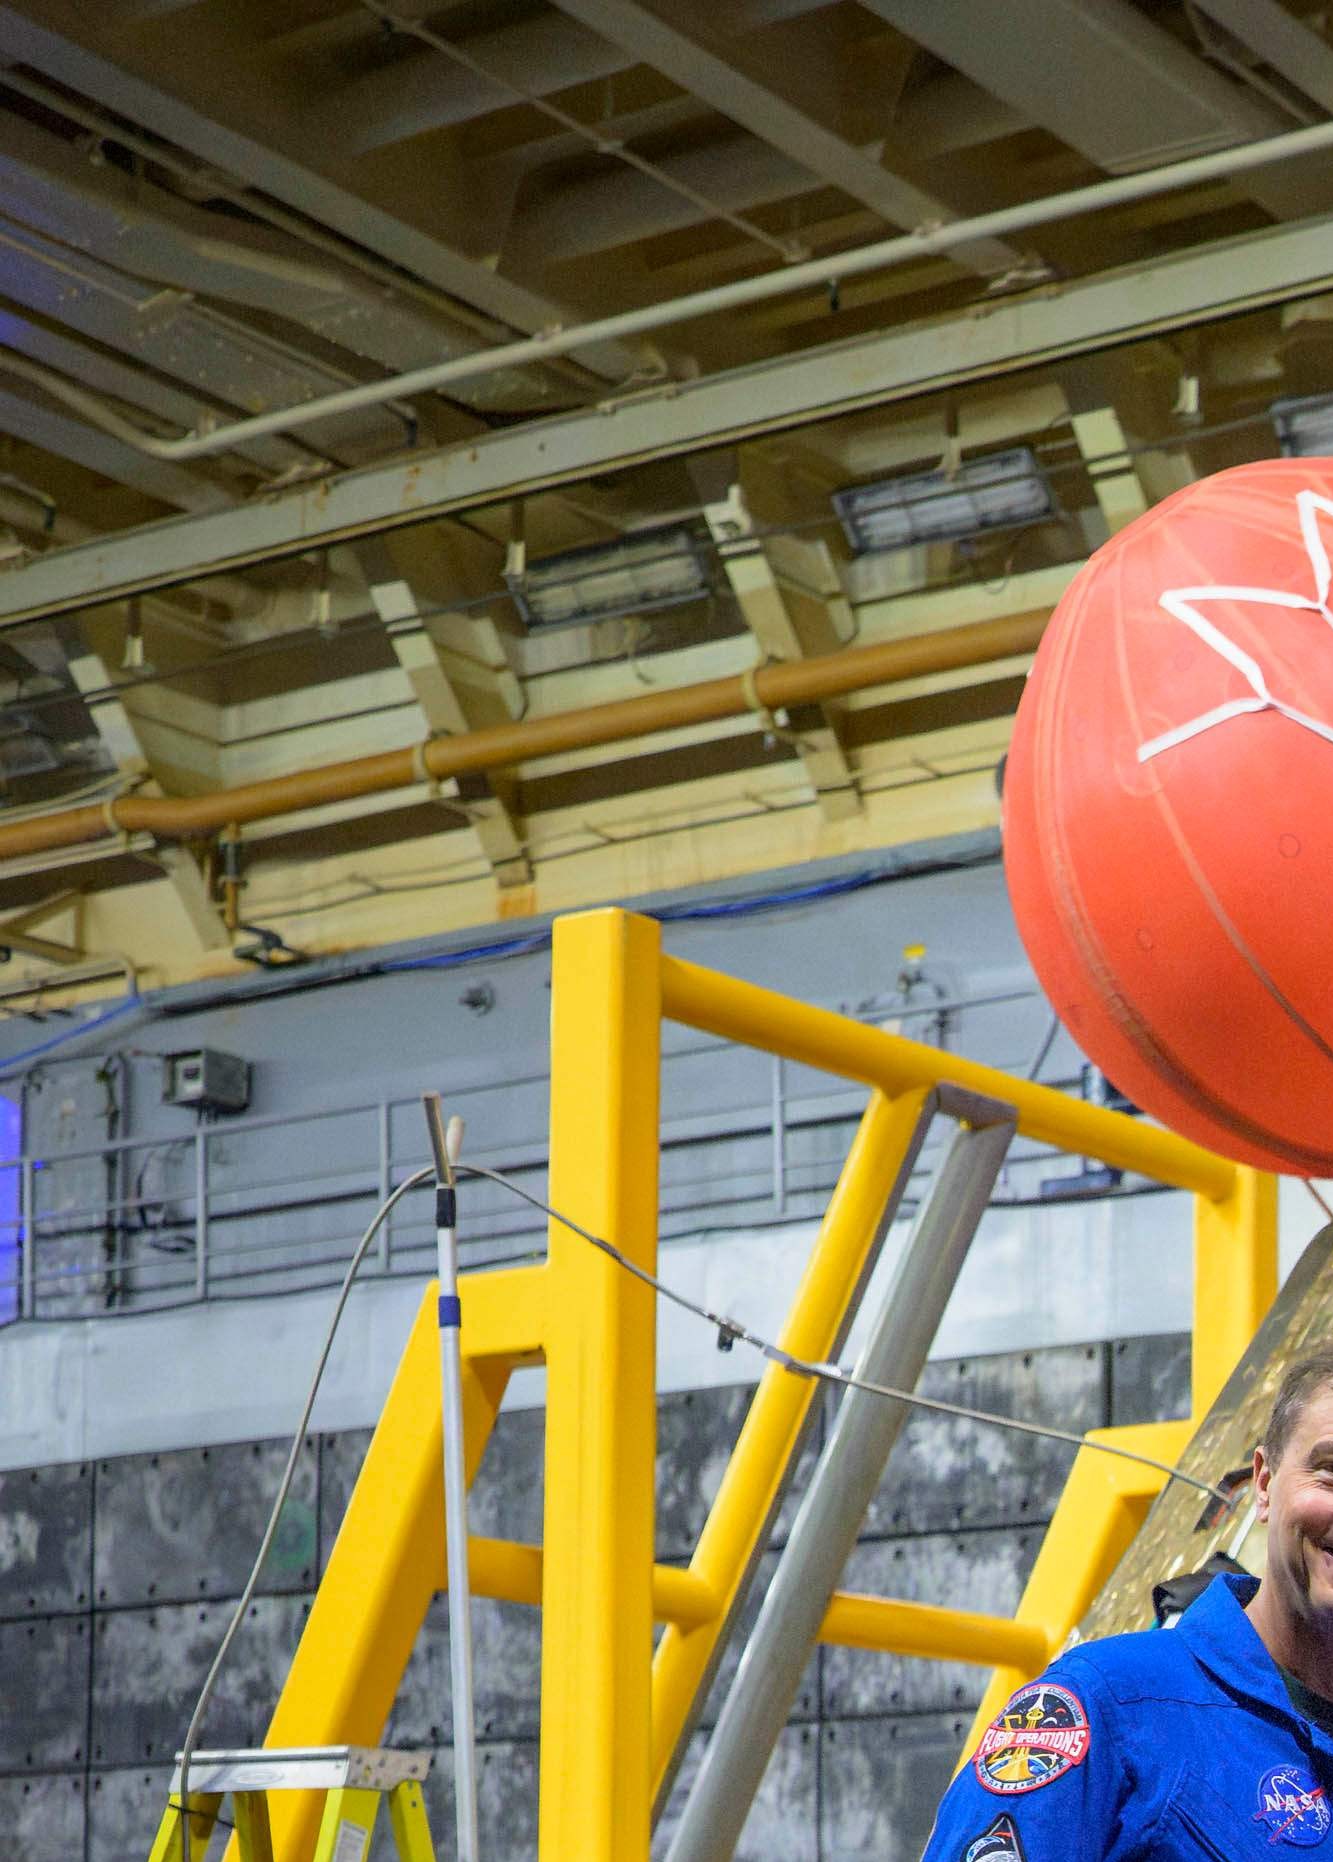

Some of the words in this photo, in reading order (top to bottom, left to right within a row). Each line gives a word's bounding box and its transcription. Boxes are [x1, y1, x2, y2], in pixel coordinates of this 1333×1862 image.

[979, 1728, 1016, 1755] FLIGHT
[1015, 1729, 1087, 1757] OPERATIONS
[1264, 1793, 1328, 1820] NASA
